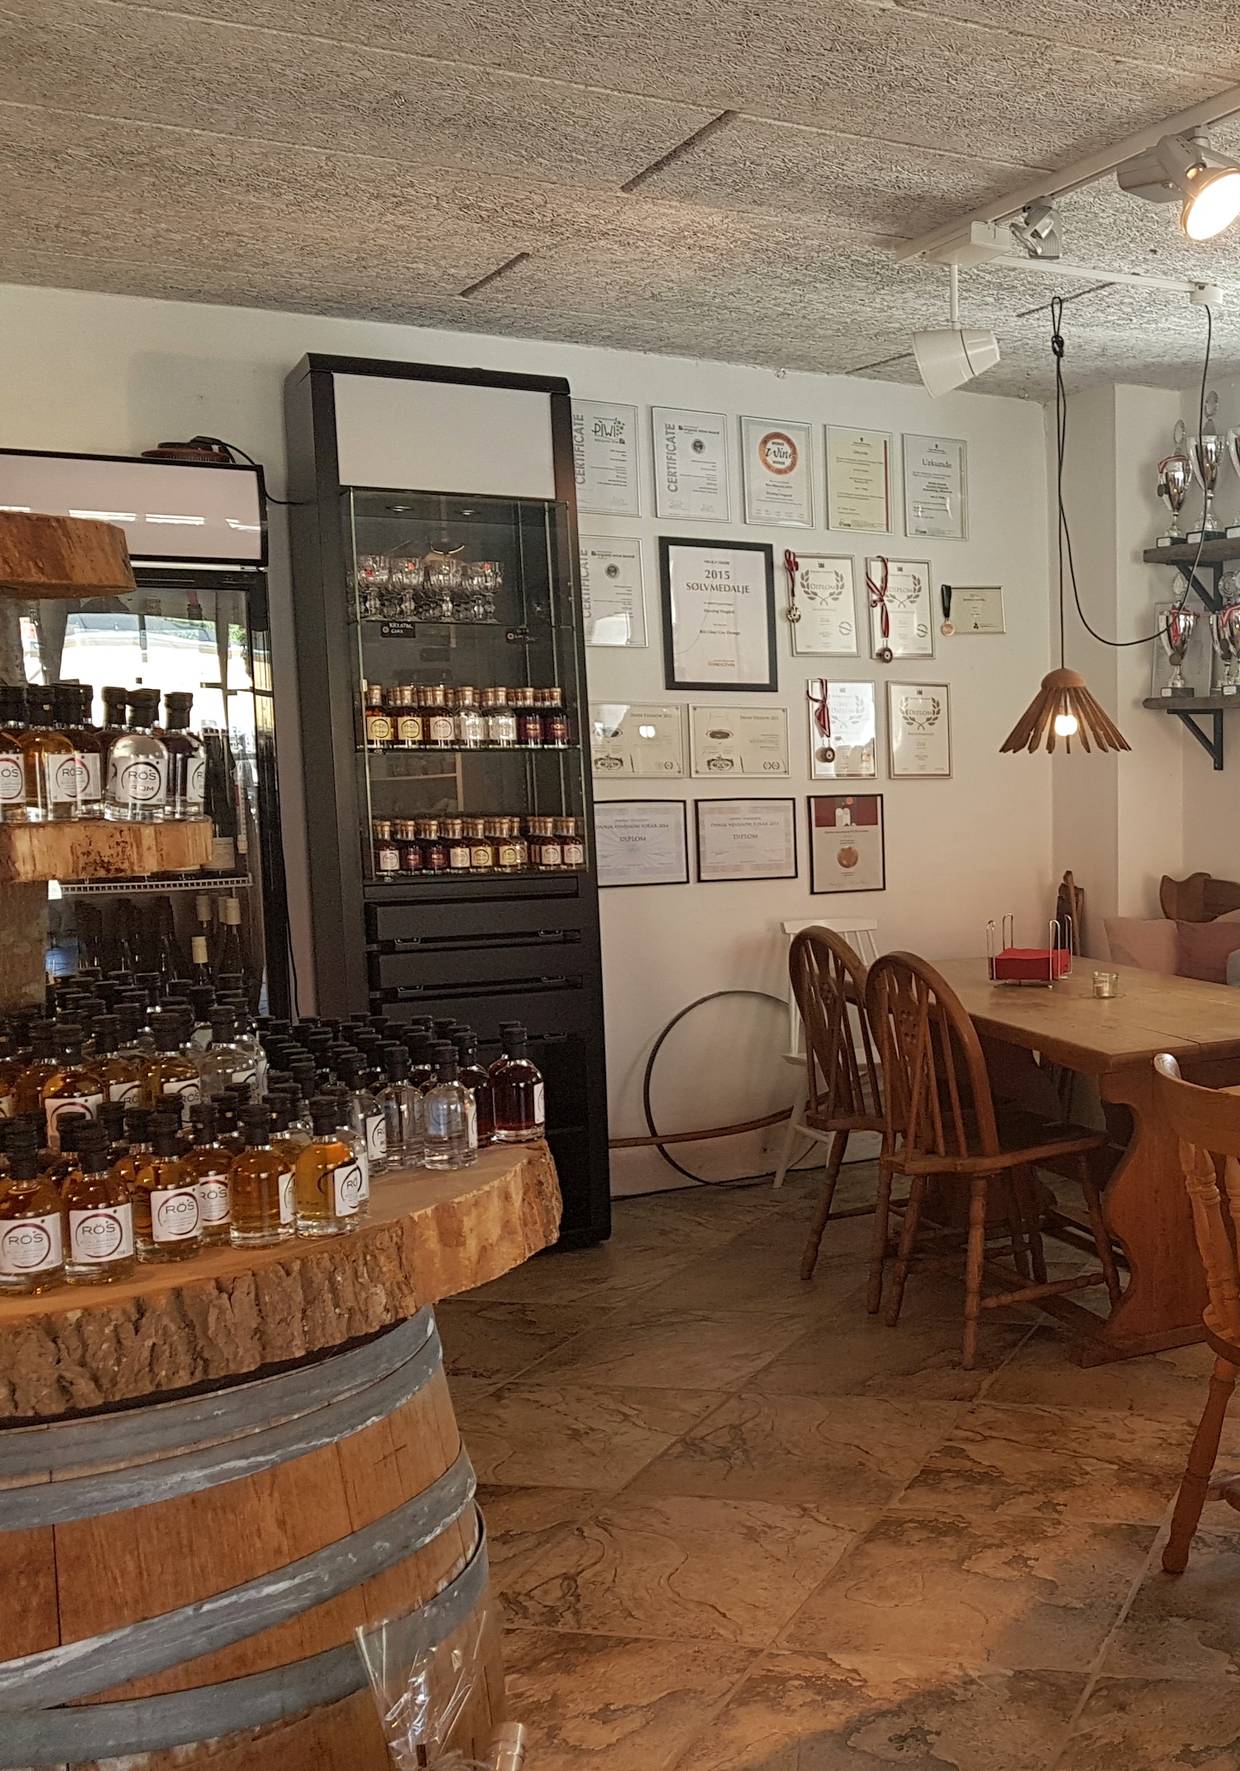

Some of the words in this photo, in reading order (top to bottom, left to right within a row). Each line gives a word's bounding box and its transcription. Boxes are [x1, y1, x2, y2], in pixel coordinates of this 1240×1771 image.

[573, 414, 586, 485] CERTIFICATE
[664, 423, 679, 493] CERTIFICATE
[580, 550, 592, 619] CERTIFICATE
[685, 582, 751, 595] SØLVMEDALJE
[704, 569, 731, 580] 2015
